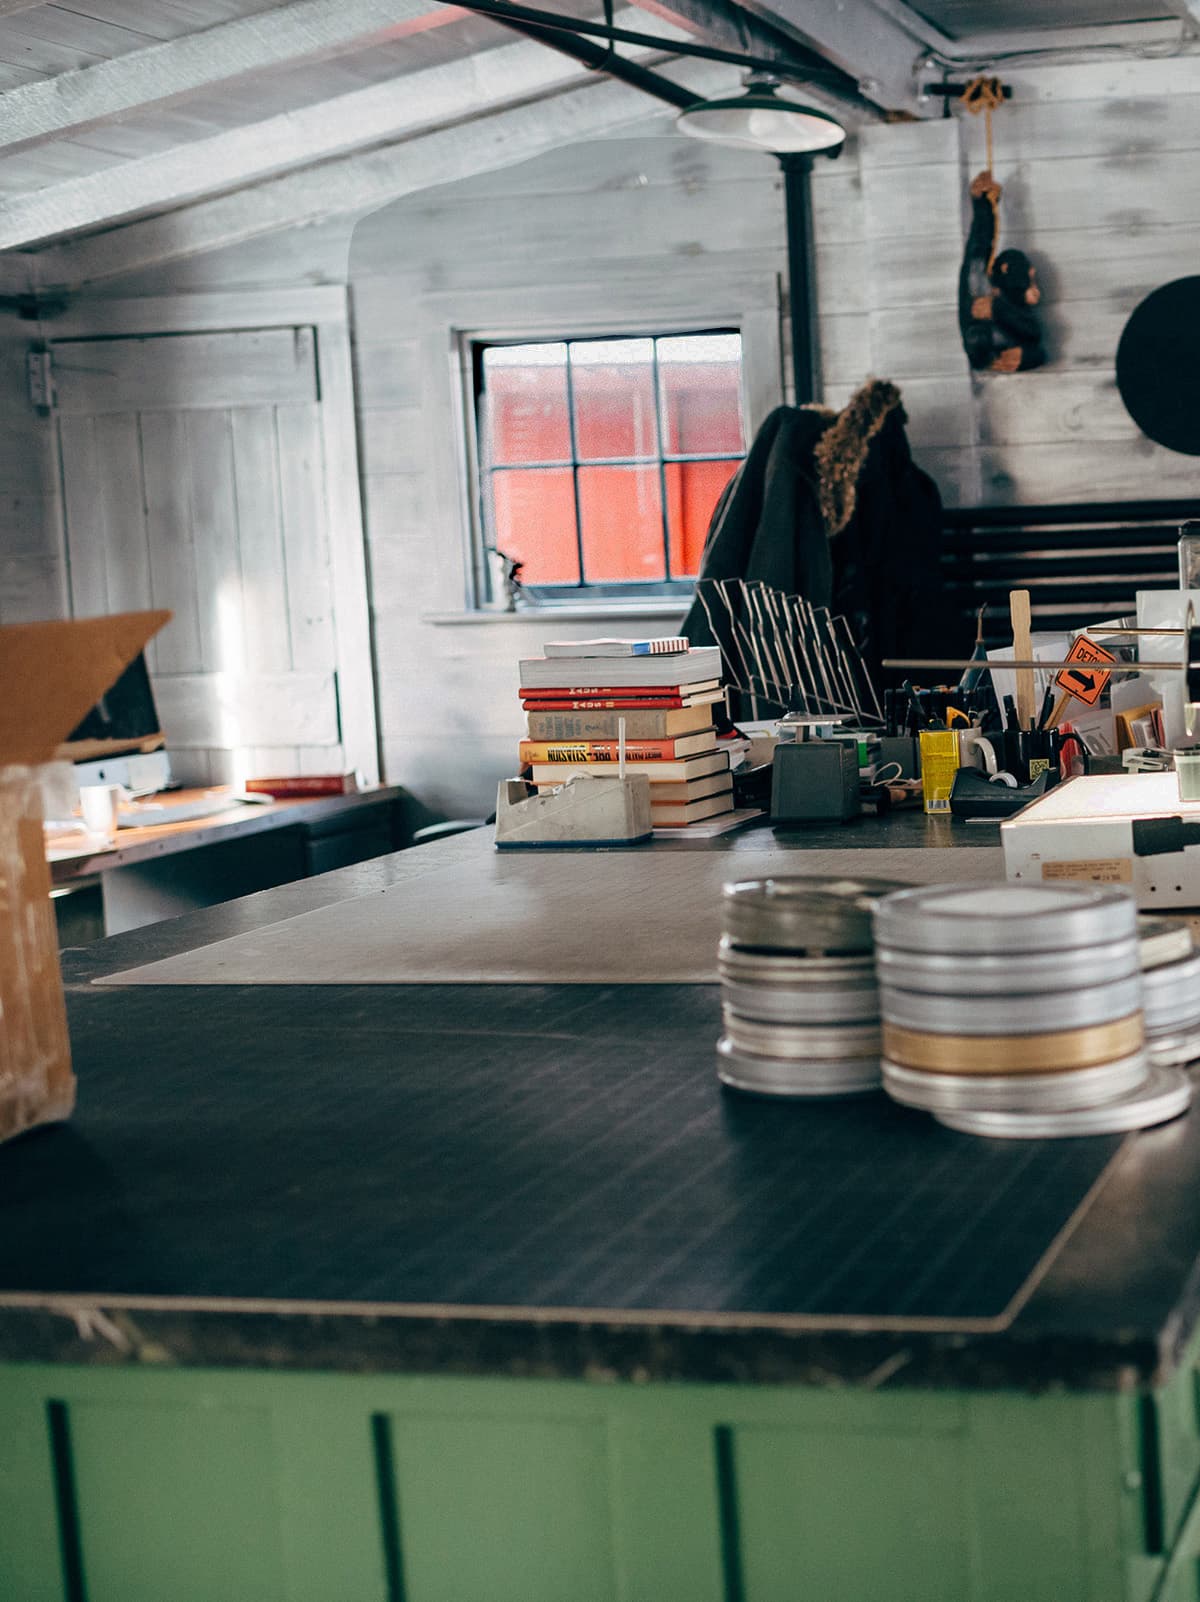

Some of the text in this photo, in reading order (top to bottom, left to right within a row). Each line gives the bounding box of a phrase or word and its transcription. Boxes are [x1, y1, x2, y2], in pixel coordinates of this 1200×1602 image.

[1076, 647, 1107, 676] DETO
[569, 687, 599, 695] MAUS
[572, 701, 602, 709] MAUS
